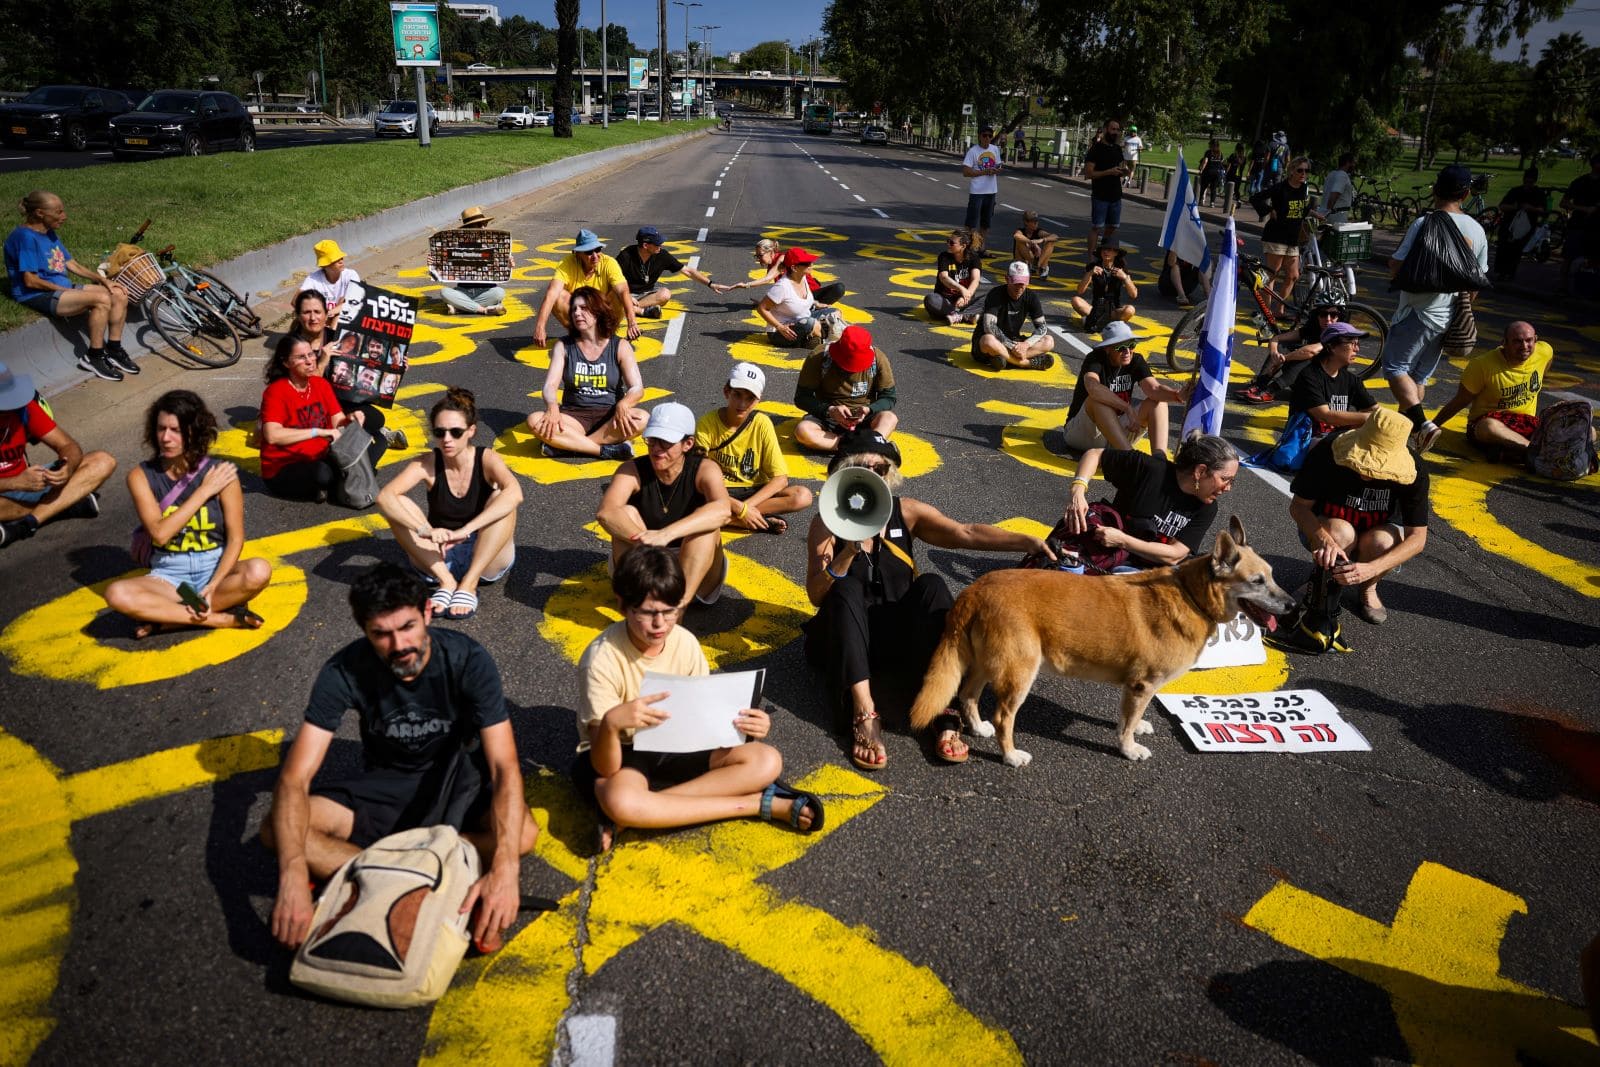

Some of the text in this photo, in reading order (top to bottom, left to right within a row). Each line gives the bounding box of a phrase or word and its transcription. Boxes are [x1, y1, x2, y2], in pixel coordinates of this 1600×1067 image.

[366, 295, 416, 325] בגללך
[361, 316, 412, 339] הם נרצחו
[574, 374, 607, 388] עדיין
[1181, 694, 1305, 709] זה כבר לא
[384, 718, 452, 738] ARMOT
[1189, 721, 1338, 745] זה רצח!
